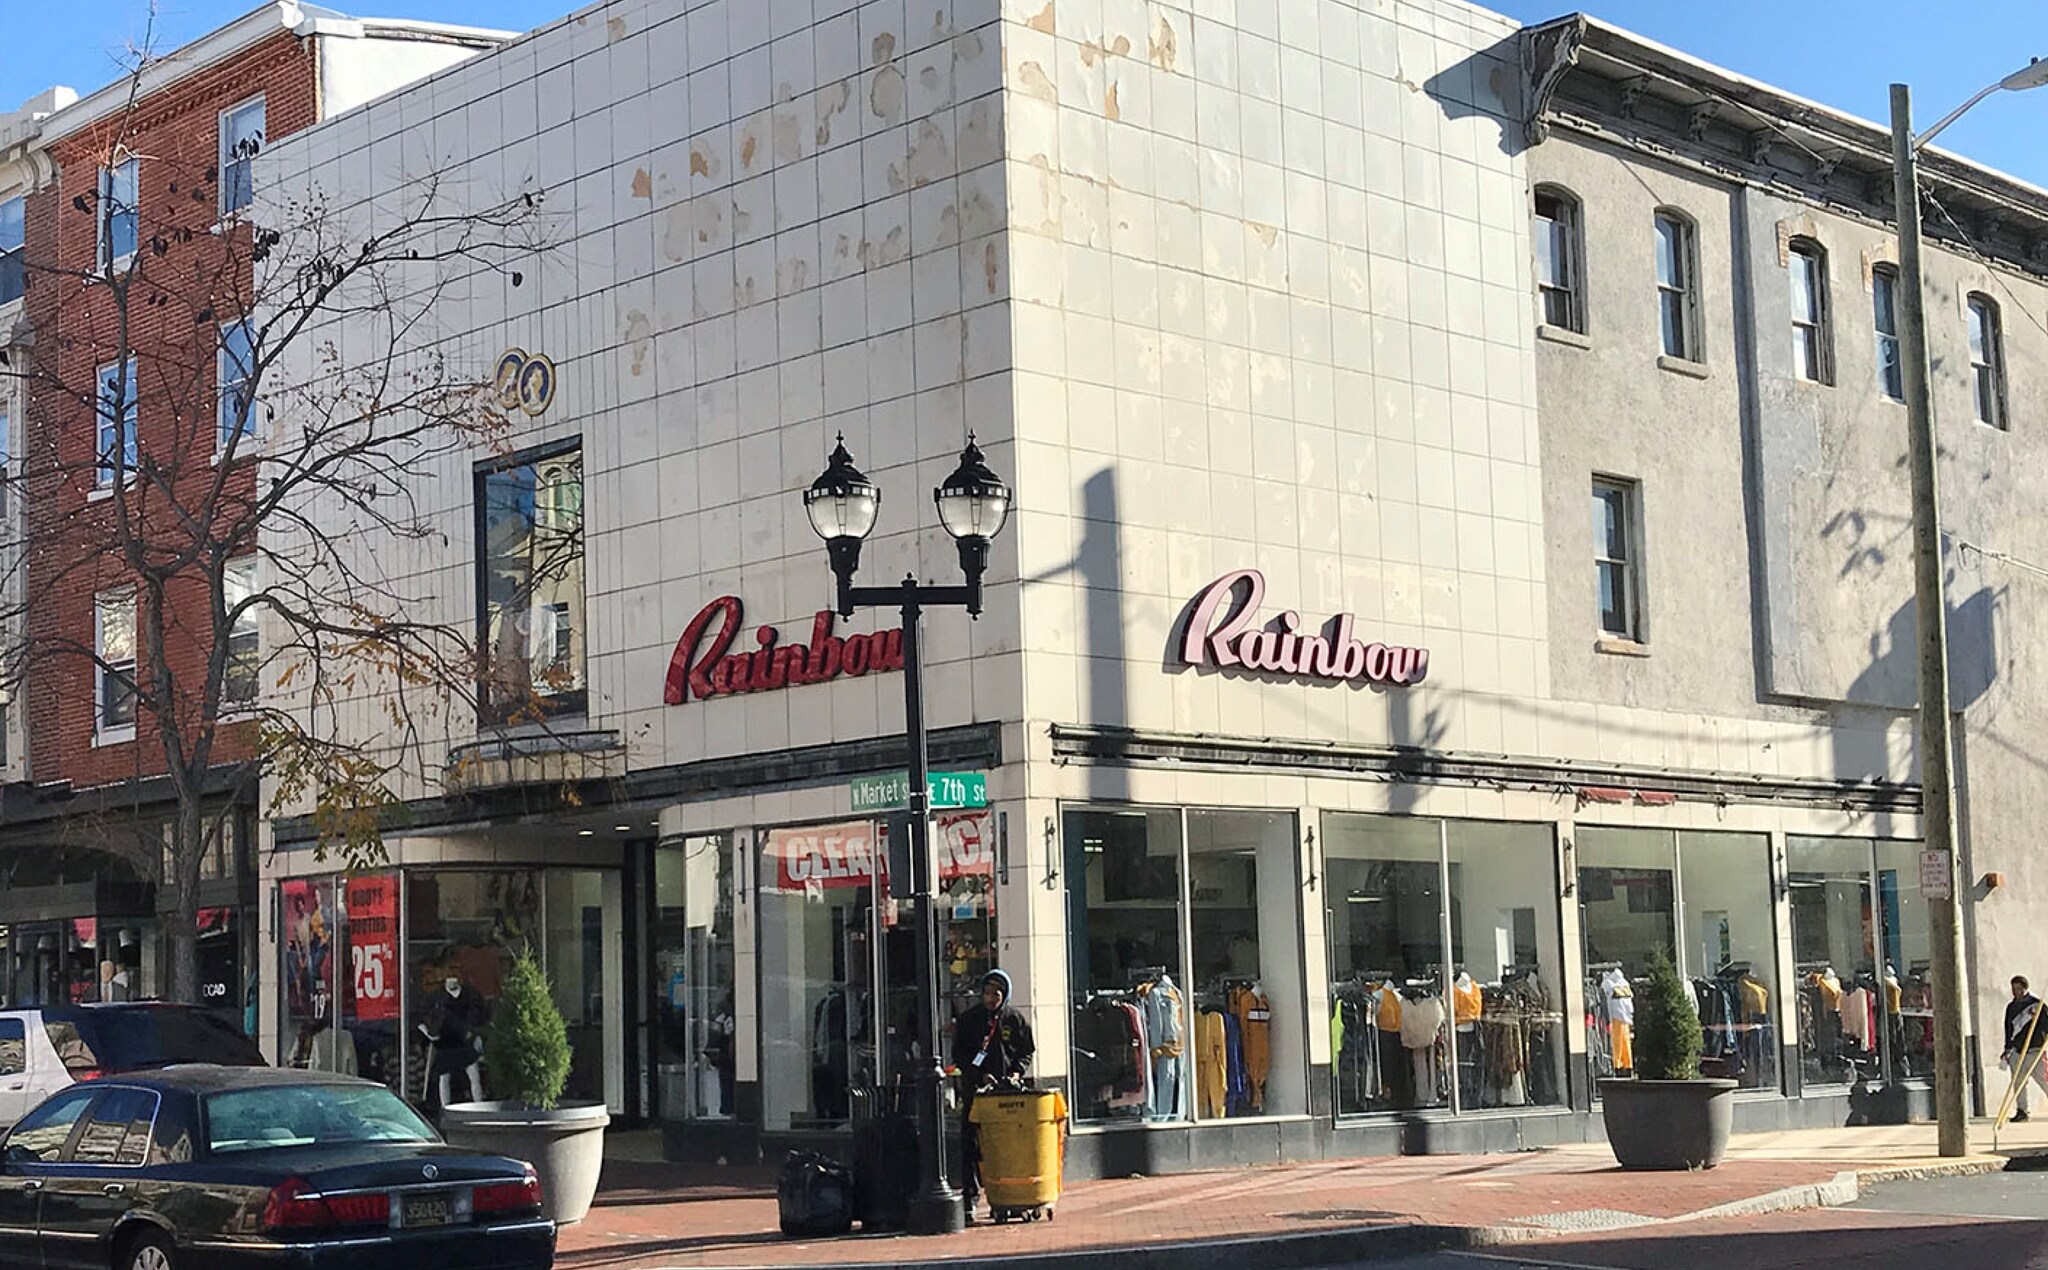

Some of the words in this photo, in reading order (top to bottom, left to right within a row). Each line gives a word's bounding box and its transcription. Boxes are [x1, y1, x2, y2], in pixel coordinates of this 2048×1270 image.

[664, 596, 906, 706] Rainbow
[1182, 569, 1430, 687] Rainbow
[861, 779, 899, 805] Market
[929, 783, 936, 801] E
[941, 777, 966, 802] 7th
